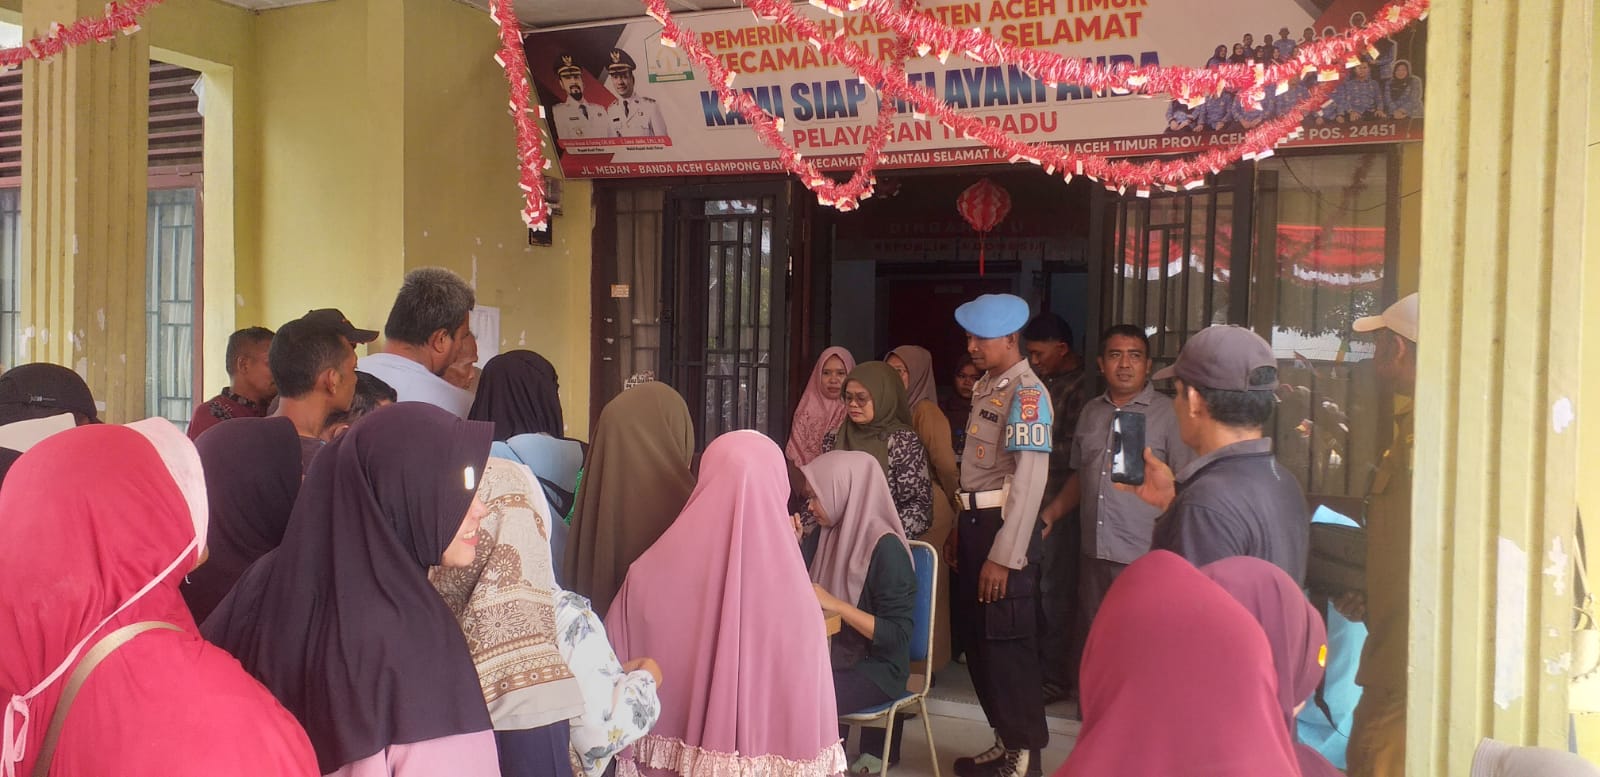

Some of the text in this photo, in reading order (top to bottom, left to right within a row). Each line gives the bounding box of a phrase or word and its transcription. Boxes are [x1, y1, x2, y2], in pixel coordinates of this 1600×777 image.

[700, 18, 837, 49] PEMERINH
[988, 0, 1056, 20] ACEH
[1002, 12, 1142, 46] SELAMAT
[791, 78, 867, 121] SIAP
[595, 165, 630, 175] MEDAN
[639, 164, 674, 174] BANDA
[676, 163, 702, 173] ACEH
[705, 161, 761, 172] GAMPONG
[933, 148, 989, 163] SELAMAT
[1074, 141, 1110, 154] ACEH
[1113, 138, 1158, 151] TIMUR
[1161, 135, 1205, 149] PROV.
[1309, 127, 1345, 141] POS.
[1350, 123, 1396, 138] 24451
[792, 120, 932, 148] PELAYAAN
